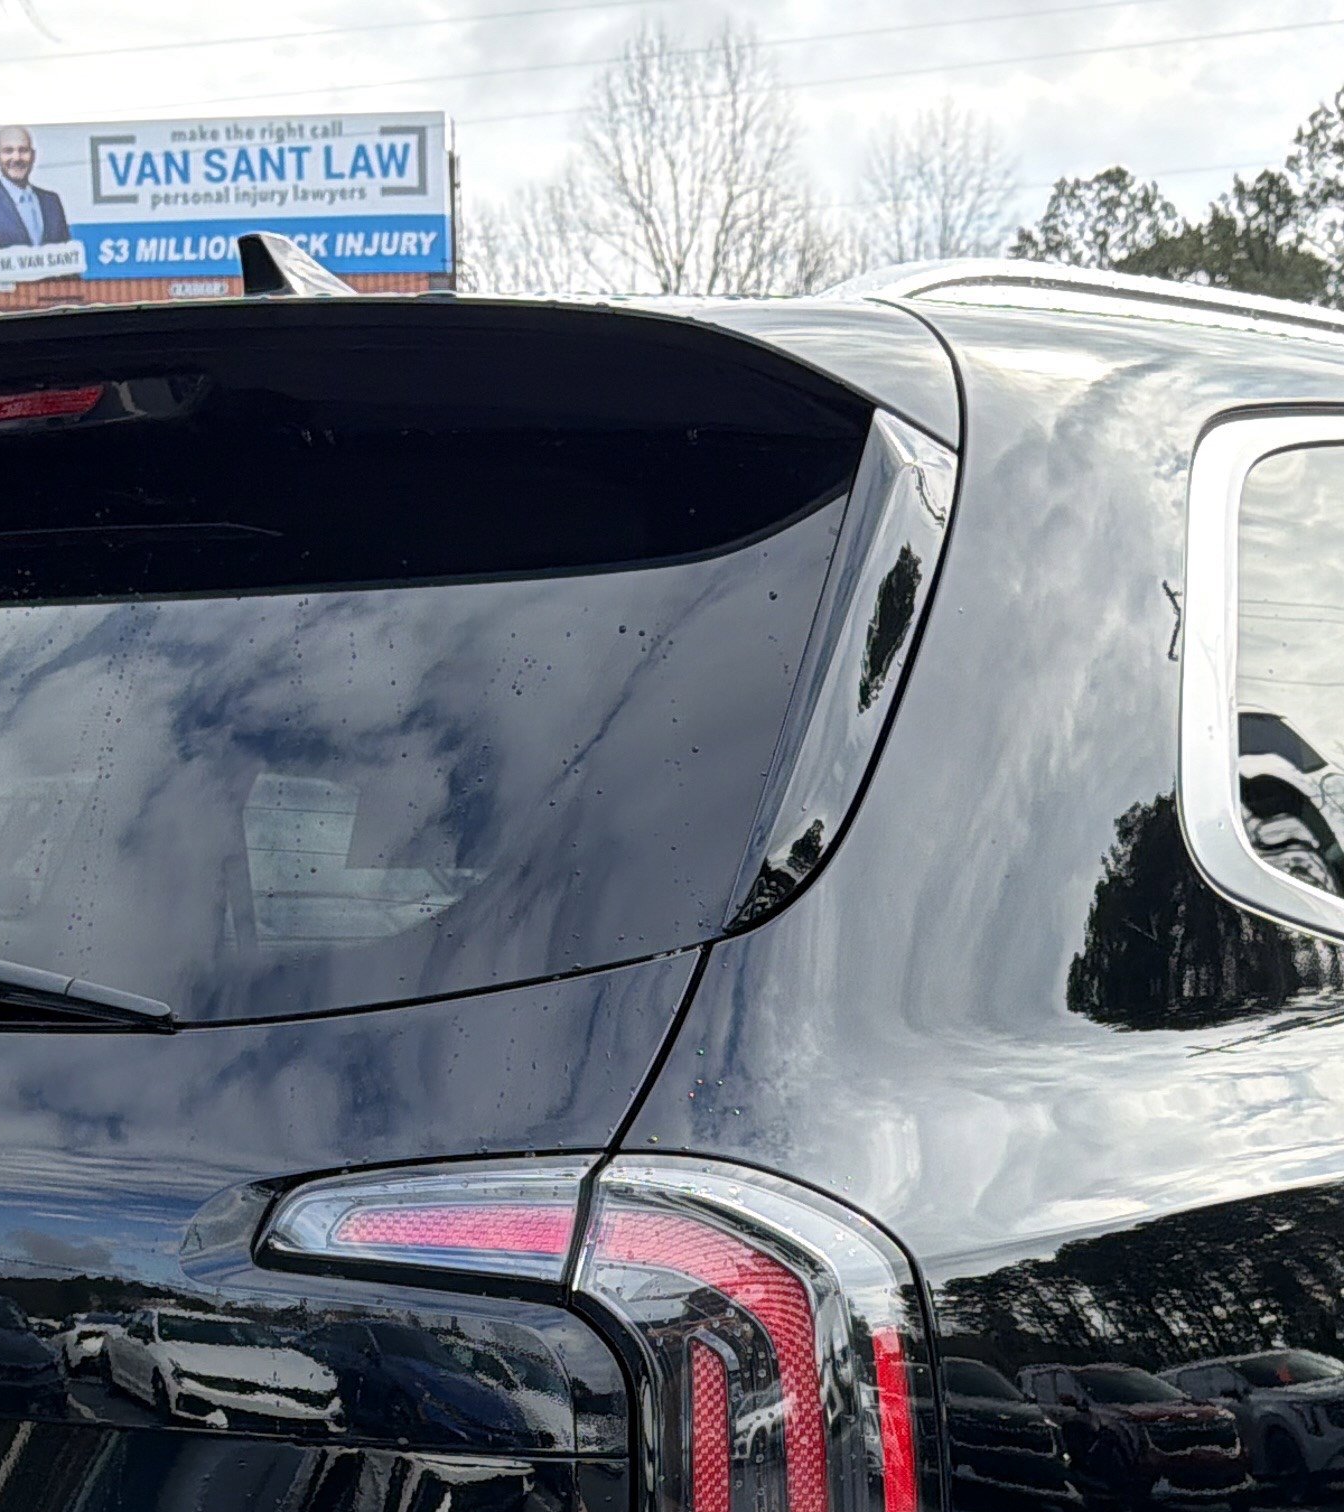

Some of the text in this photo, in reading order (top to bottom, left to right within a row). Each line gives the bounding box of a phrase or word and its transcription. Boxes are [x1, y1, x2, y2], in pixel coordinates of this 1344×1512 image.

[171, 120, 343, 145] make the right call
[108, 143, 410, 186] VAN SANT LAW
[150, 183, 367, 209] personal injury lawyers
[99, 238, 129, 264] $3
[335, 231, 437, 257] INJURY
[17, 254, 44, 270] VAN
